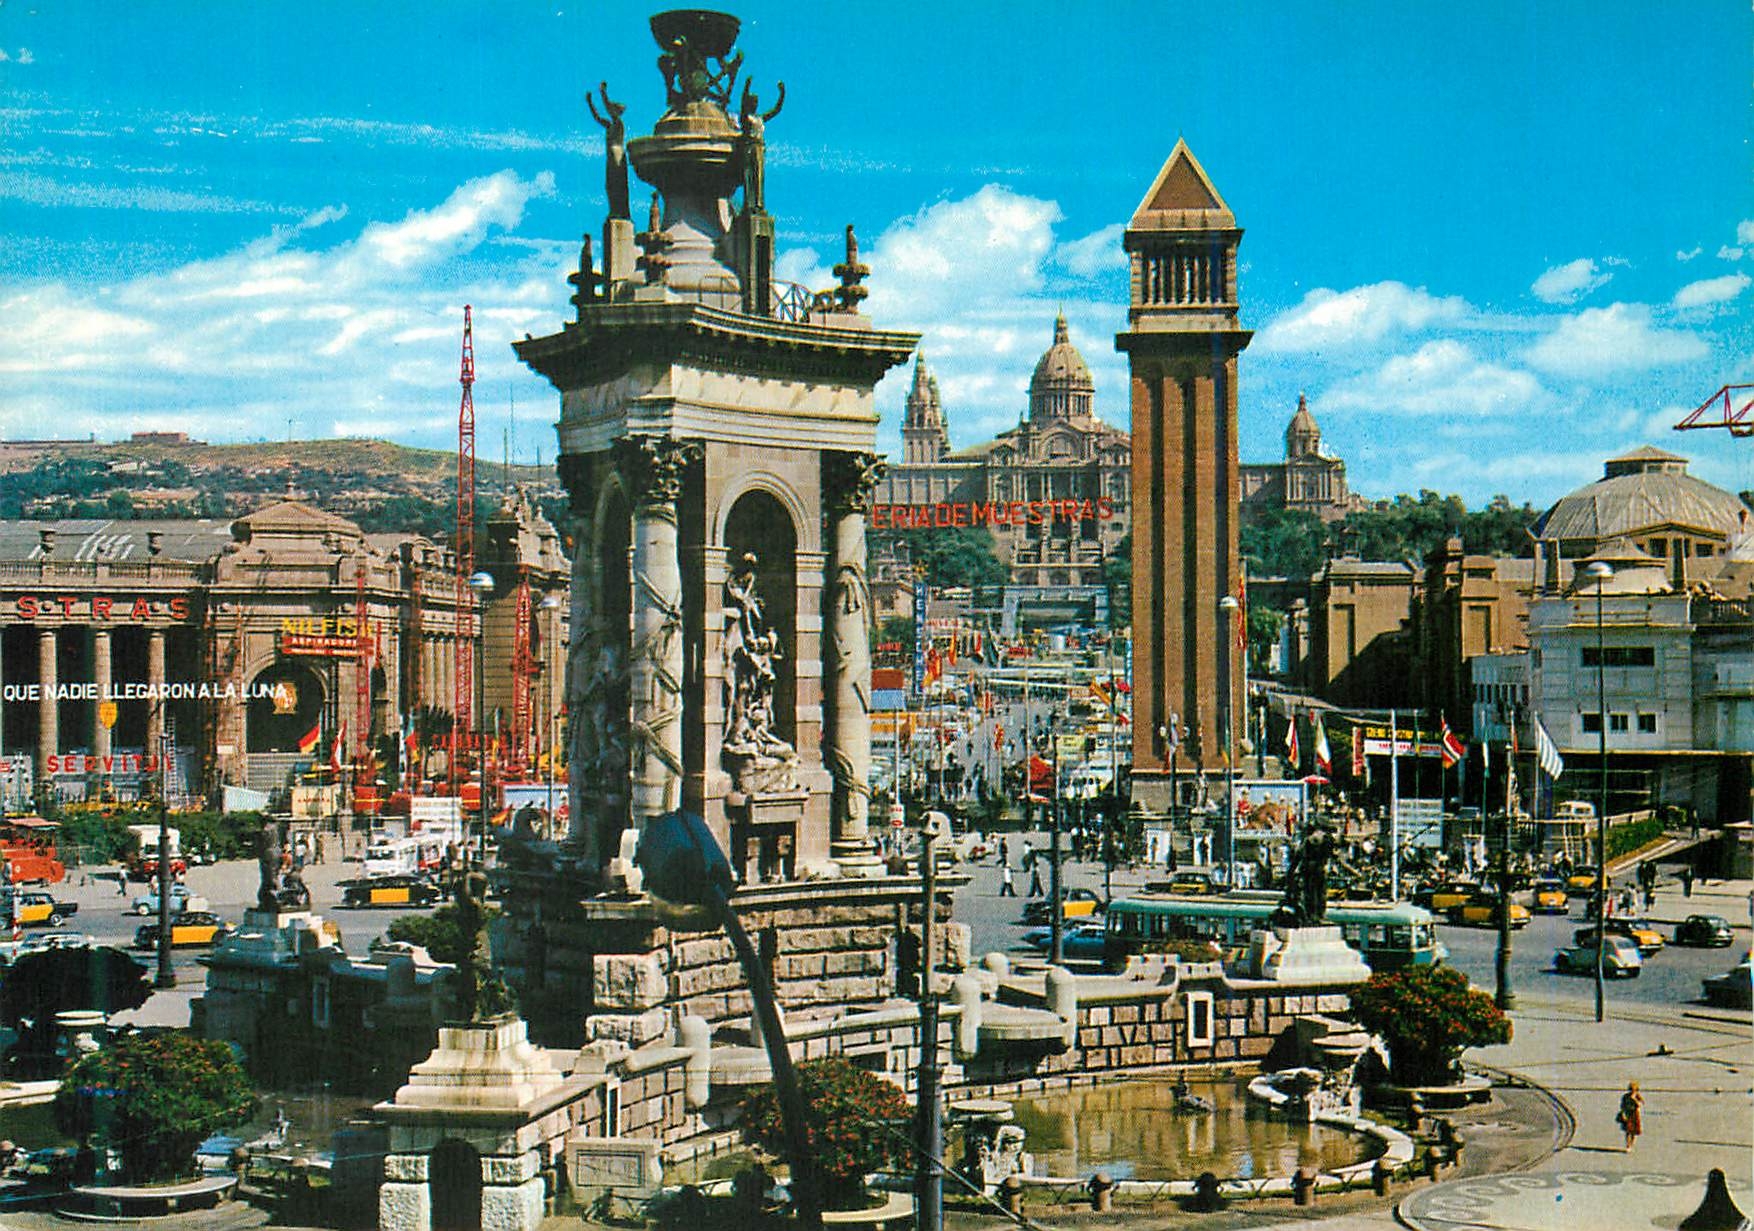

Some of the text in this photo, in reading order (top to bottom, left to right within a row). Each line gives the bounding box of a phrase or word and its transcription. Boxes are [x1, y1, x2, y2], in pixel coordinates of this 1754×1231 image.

[934, 502, 968, 528] DE
[972, 496, 1114, 526] MUESTRAS
[3, 682, 287, 701] QUE NADIE LLEGARON A LA LUNA
